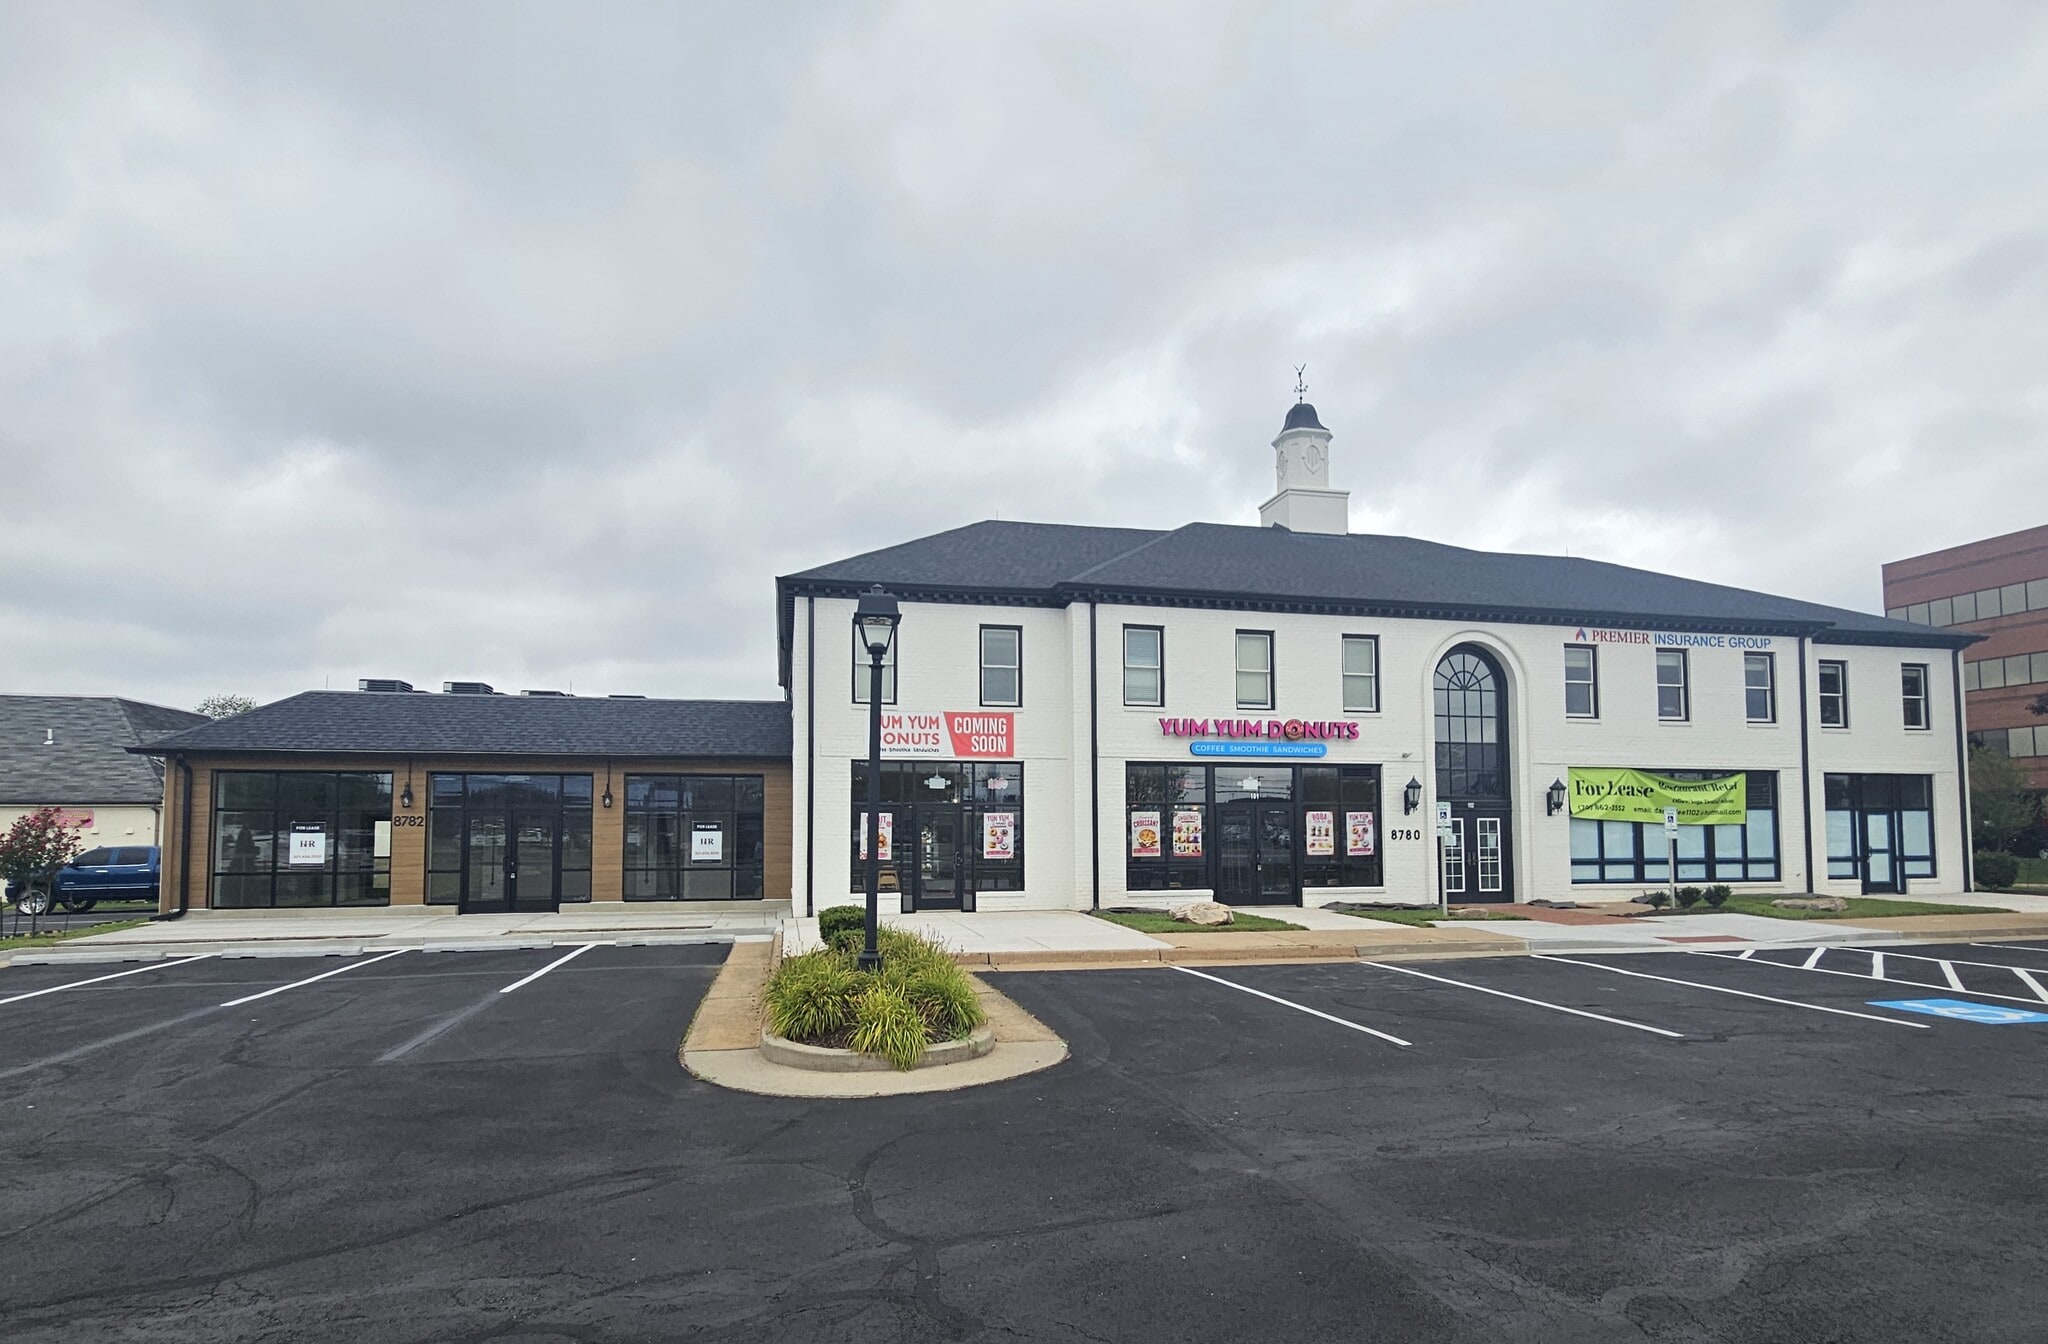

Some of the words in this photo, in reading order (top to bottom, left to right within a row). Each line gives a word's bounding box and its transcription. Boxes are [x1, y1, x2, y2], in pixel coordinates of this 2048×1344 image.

[1592, 630, 1650, 645] PREMIER
[1654, 633, 1725, 648] INSURANCE
[1728, 637, 1772, 649] GROUP
[881, 715, 902, 729] UM
[907, 715, 940, 730] YUM
[954, 717, 1007, 734] COMING
[1159, 718, 1209, 737] YUM
[1213, 719, 1263, 738] YUM
[1268, 718, 1360, 741] DONUTS
[881, 732, 940, 745] ONUTS
[971, 735, 1007, 752] SOON
[1195, 744, 1226, 753] COFFEE
[1229, 745, 1269, 754] SMOOTHIE
[1272, 745, 1324, 754] SANDWICHES
[1575, 779, 1605, 796] For
[1606, 780, 1655, 798] Lease
[393, 815, 425, 827] 8782
[1391, 829, 1420, 840] 8780
